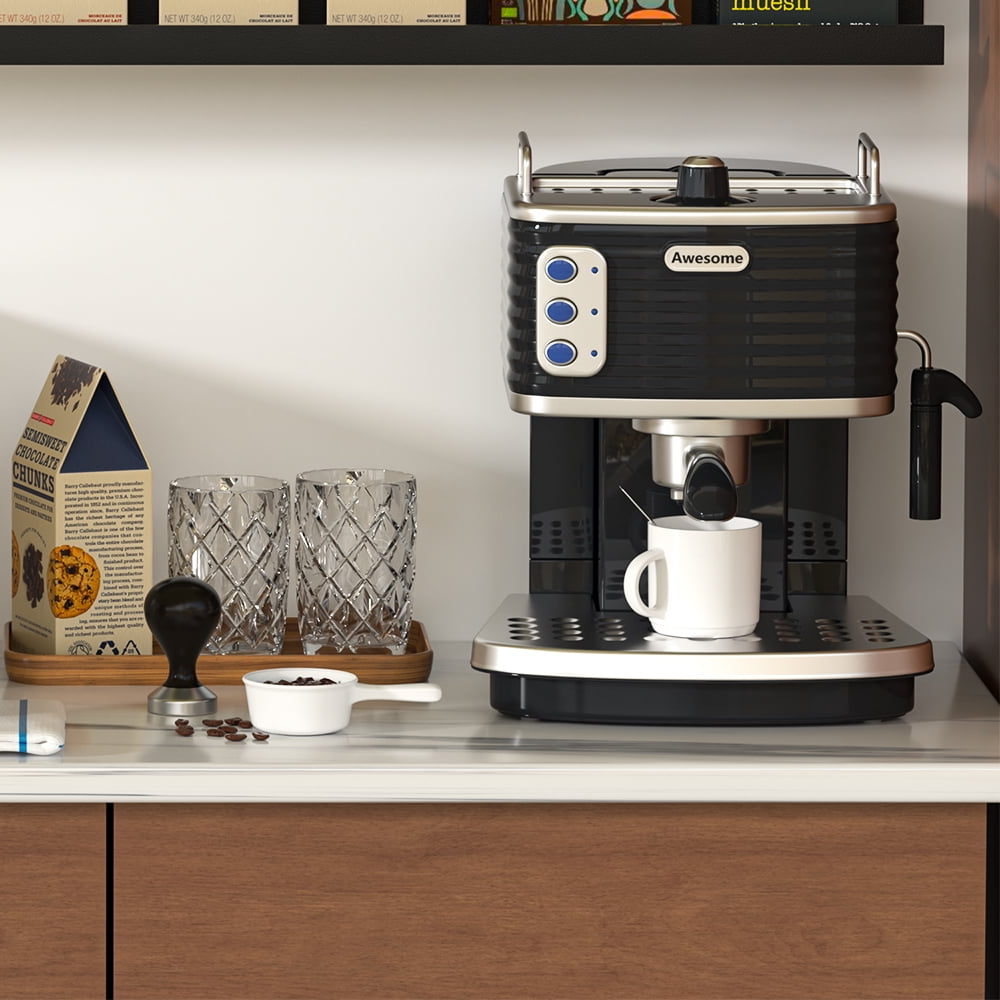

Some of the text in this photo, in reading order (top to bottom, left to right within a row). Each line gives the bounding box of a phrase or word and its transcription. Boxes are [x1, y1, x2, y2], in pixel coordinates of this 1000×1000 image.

[7, 14, 18, 23] WT
[20, 14, 37, 24] 340g
[164, 14, 177, 23] NET
[178, 14, 189, 23] WT
[191, 14, 208, 24] 340g
[332, 14, 345, 23] NET
[346, 14, 357, 23] WT
[359, 14, 376, 24] 340g
[671, 252, 743, 265] Awesome
[22, 427, 68, 453] SEMISWEET
[15, 443, 60, 470] CHOCOLATE
[12, 461, 55, 494] CHUNKS
